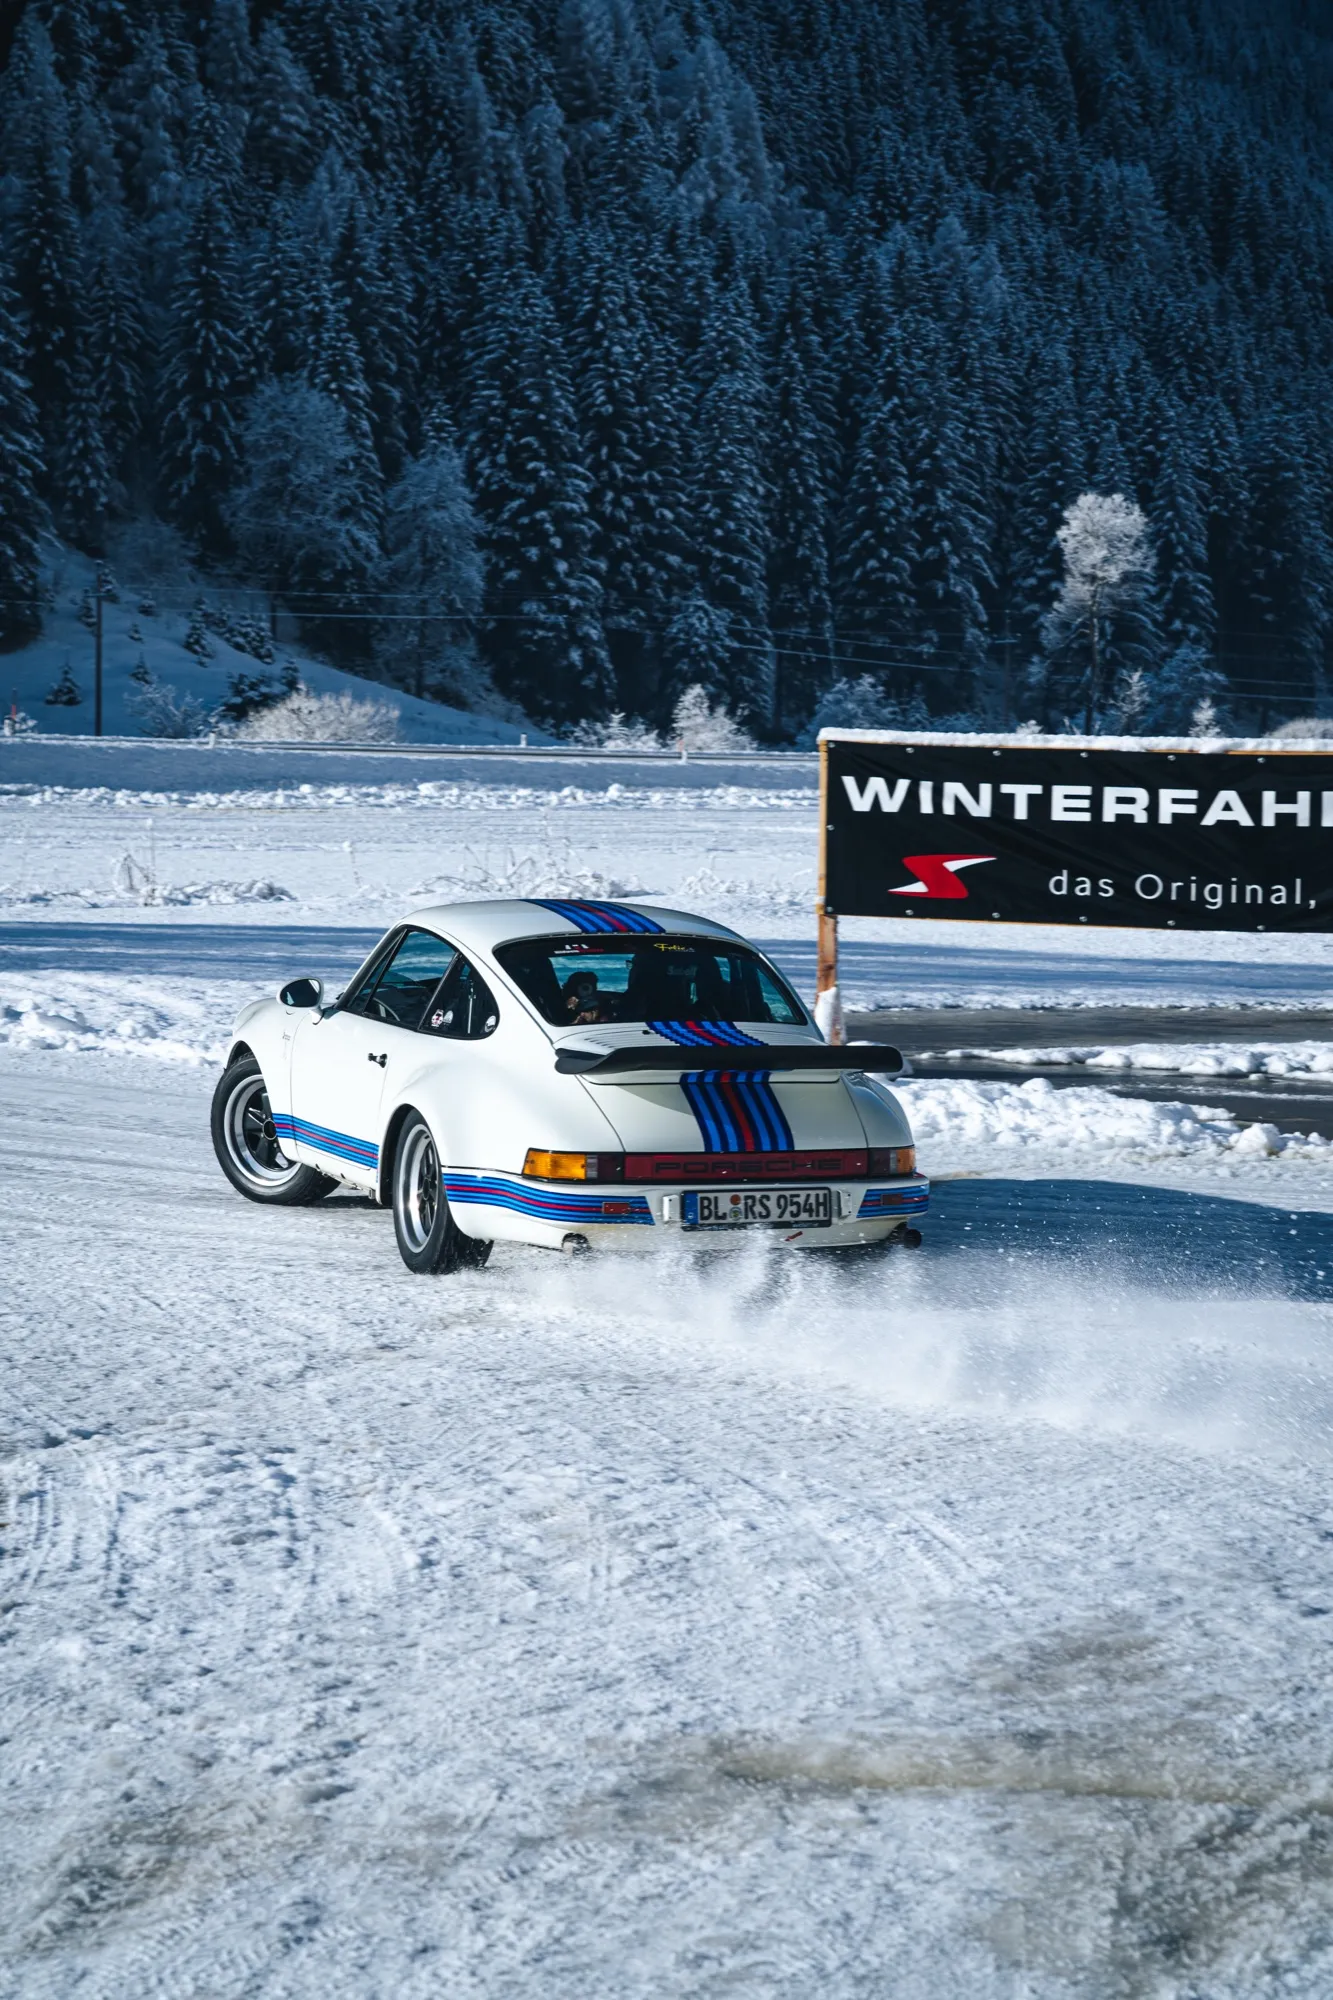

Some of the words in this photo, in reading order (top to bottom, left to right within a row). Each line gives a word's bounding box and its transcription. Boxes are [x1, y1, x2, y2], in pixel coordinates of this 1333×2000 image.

[840, 775, 1333, 828] WINTERFAH
[1048, 870, 1115, 897] das
[1134, 873, 1317, 909] Original,
[655, 1159, 843, 1174] PORSCHE
[699, 1196, 727, 1221] BL
[744, 1194, 771, 1220] RS
[776, 1192, 828, 1219] 954H
